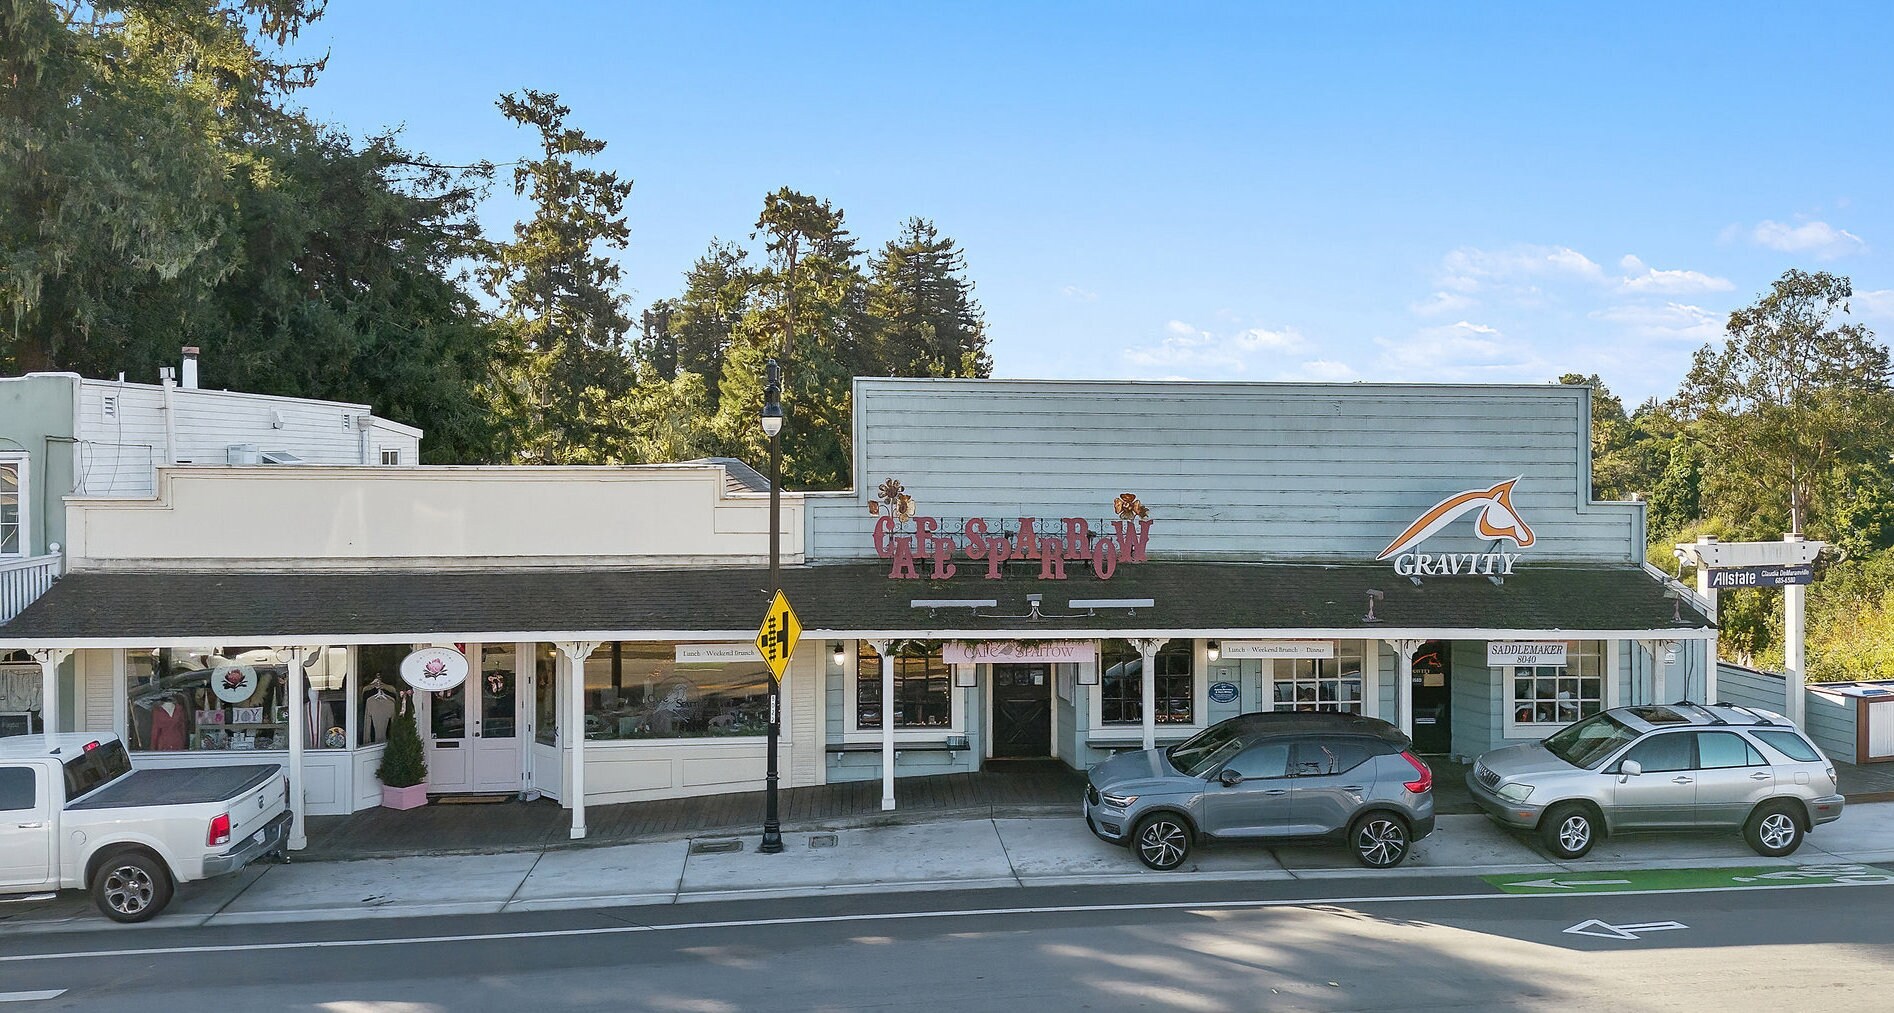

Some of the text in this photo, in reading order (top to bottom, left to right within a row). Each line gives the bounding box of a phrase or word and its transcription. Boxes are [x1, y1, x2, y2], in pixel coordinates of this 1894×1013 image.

[872, 515, 1154, 580] CAFE SPARROW
[1394, 553, 1521, 576] GRAVITY
[1713, 571, 1756, 586] Allstate
[1491, 644, 1564, 655] SADDLEMAKER
[1517, 655, 1537, 663] 8040
